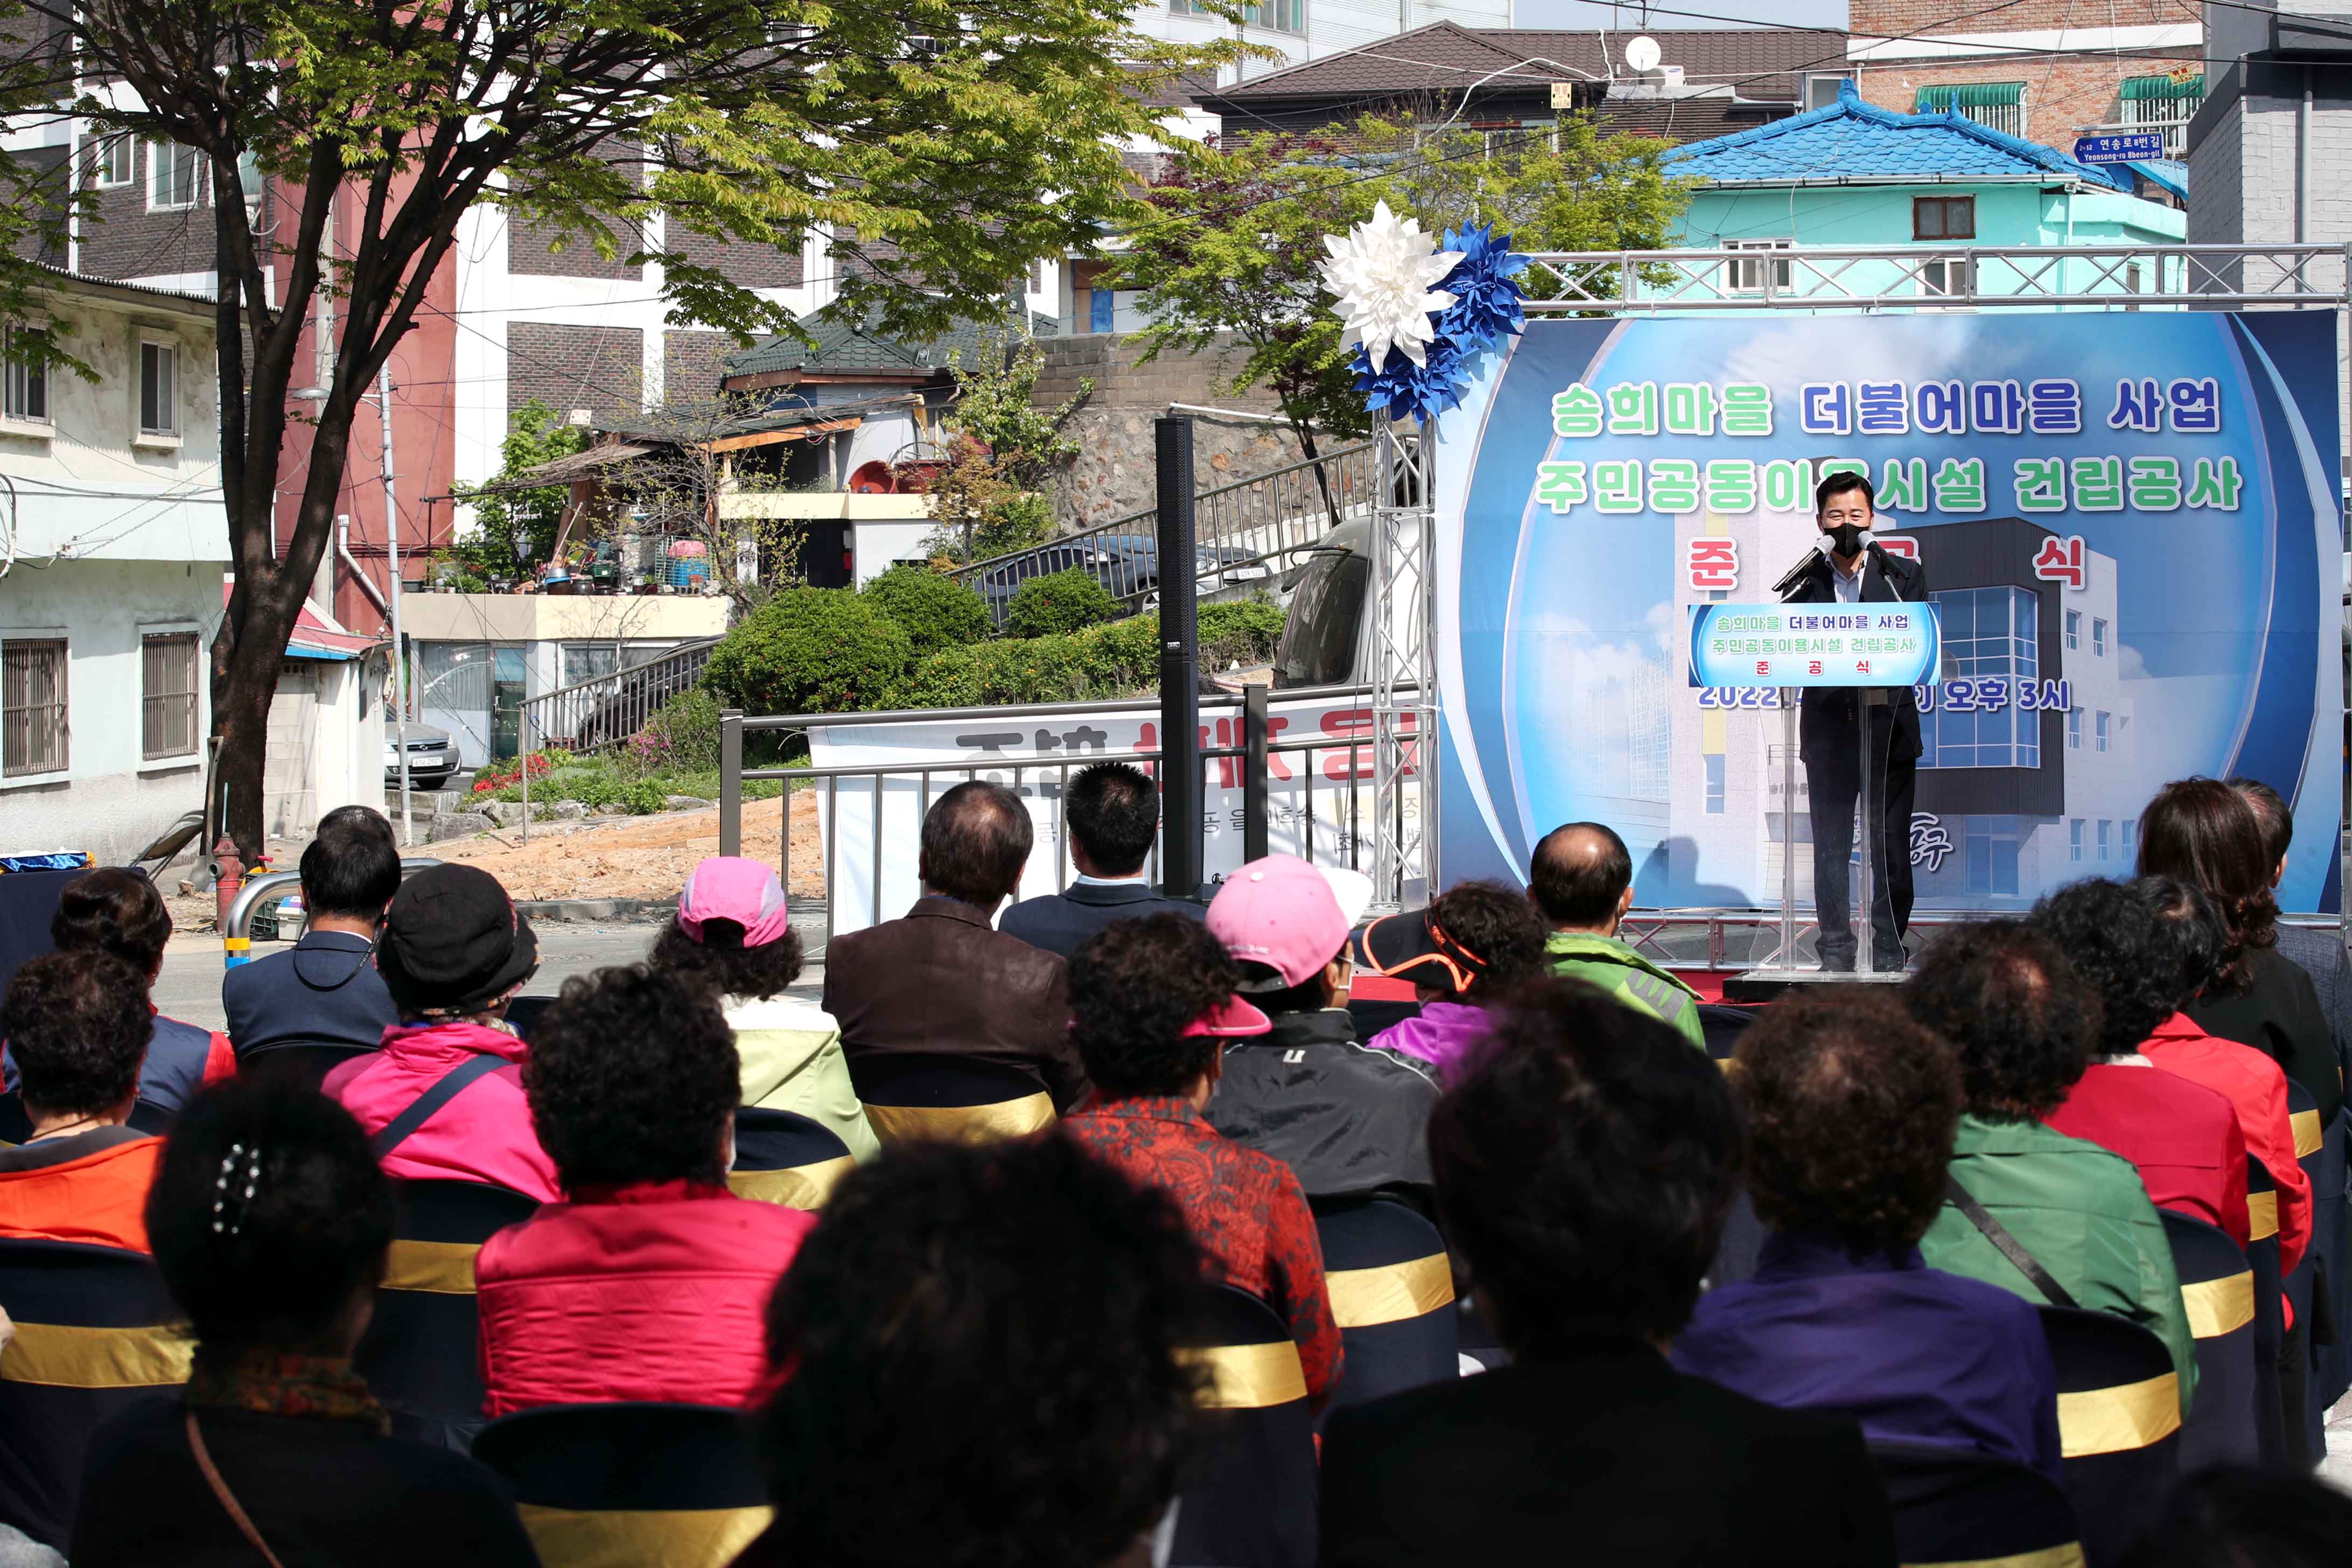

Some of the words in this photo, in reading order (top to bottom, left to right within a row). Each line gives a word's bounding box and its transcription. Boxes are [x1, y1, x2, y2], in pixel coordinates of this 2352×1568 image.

[2084, 153, 2126, 162] Yeonsong-ro
[2127, 150, 2160, 159] 8beon-gil
[1555, 384, 1770, 435] 송희마을
[1803, 381, 2078, 432] 더불어마을
[2110, 379, 2219, 431] 사업
[1537, 458, 1984, 512] 주민공동이시설
[2015, 458, 2240, 510] 건립공사
[1689, 538, 1735, 589] 준
[2035, 537, 2084, 588] 식
[1716, 615, 1781, 631] 송희마을
[1789, 615, 1869, 630] 더불어마을
[1878, 614, 1909, 629] 사업
[1712, 639, 1842, 654] 주민공동이용시설
[1850, 637, 1916, 652] 건립공사
[1756, 661, 1770, 675] 준
[1808, 661, 1823, 675] 공
[1856, 660, 1871, 674] 식
[1945, 678, 2007, 710] 오후
[2019, 678, 2070, 710] 3시
